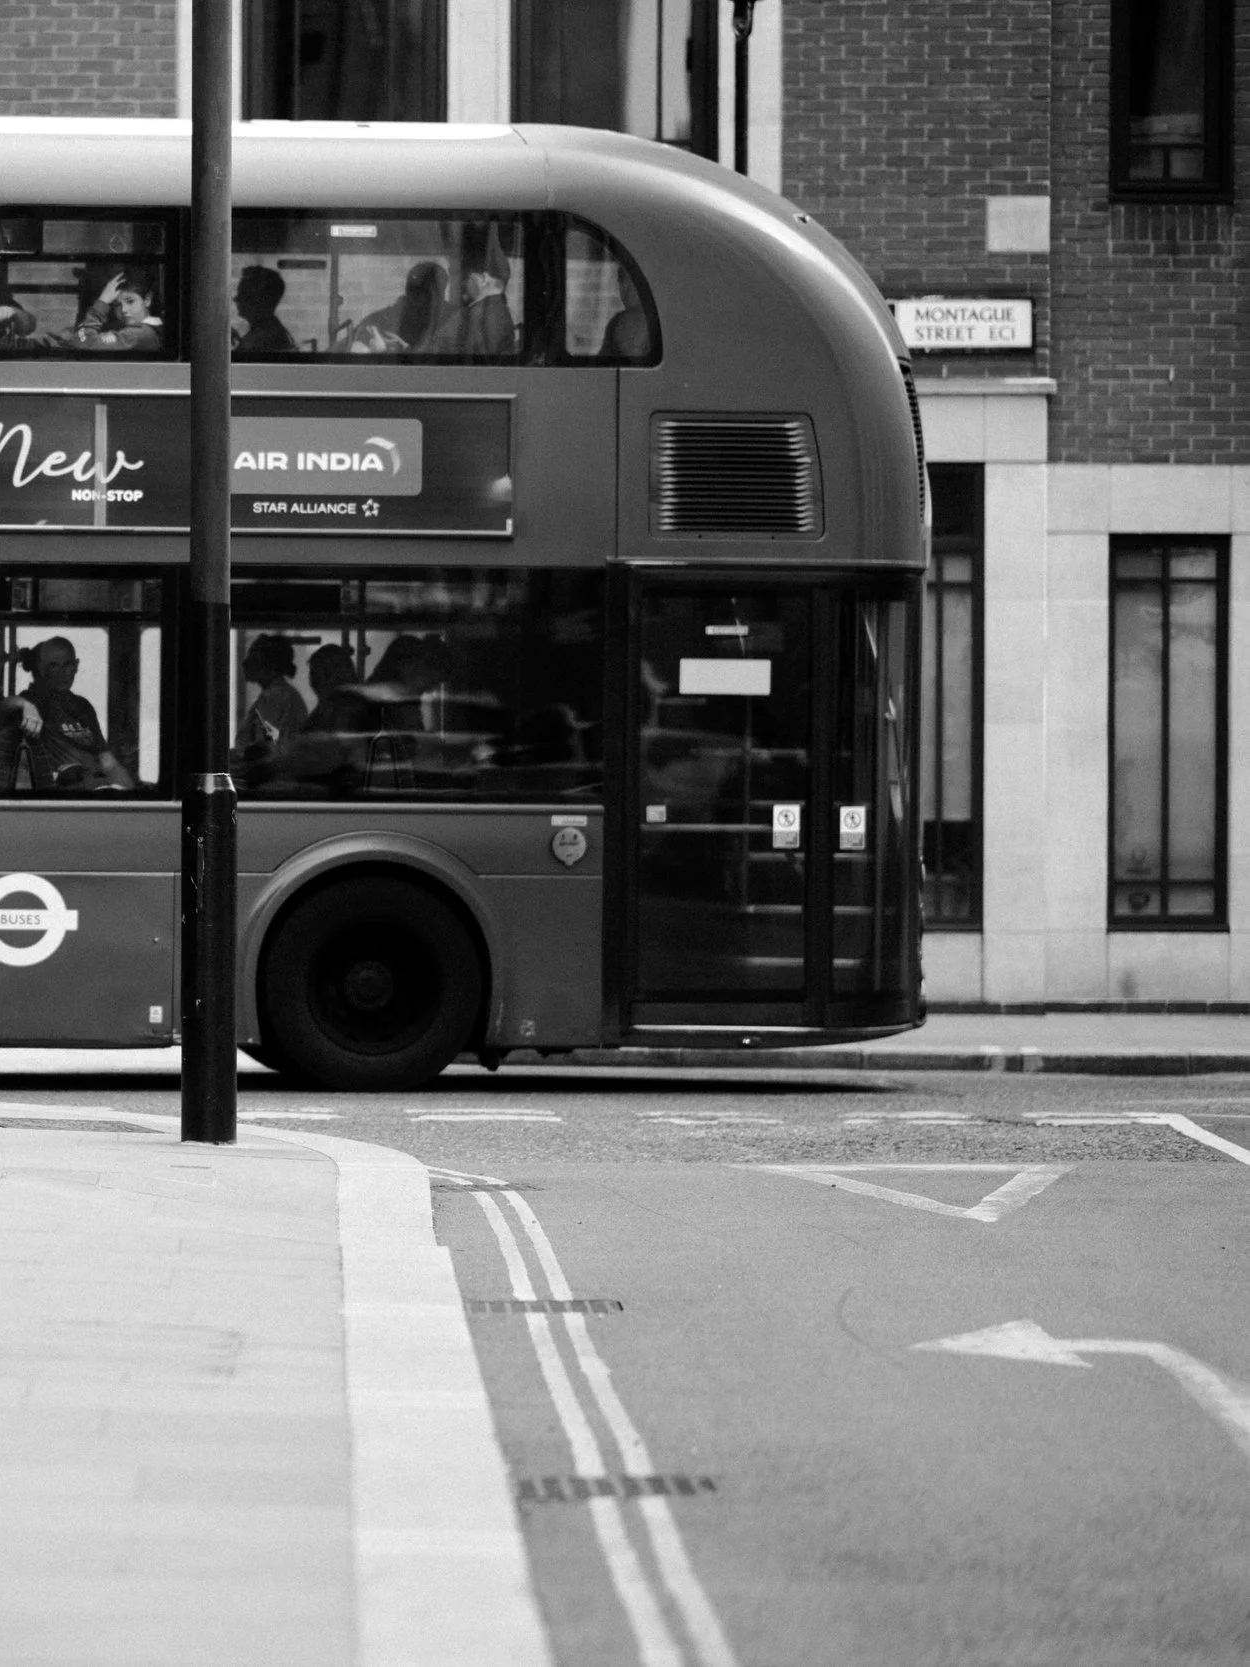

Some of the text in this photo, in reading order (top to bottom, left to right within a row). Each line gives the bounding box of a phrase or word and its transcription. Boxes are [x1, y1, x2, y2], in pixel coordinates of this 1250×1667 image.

[914, 306, 1015, 323] MONTAGUE
[914, 325, 975, 342] STREET
[233, 451, 384, 472] AIR INDIA
[71, 489, 144, 502] NON-STOP
[252, 501, 357, 516] STAR ALLIANCE
[0, 913, 42, 926] BUSES
